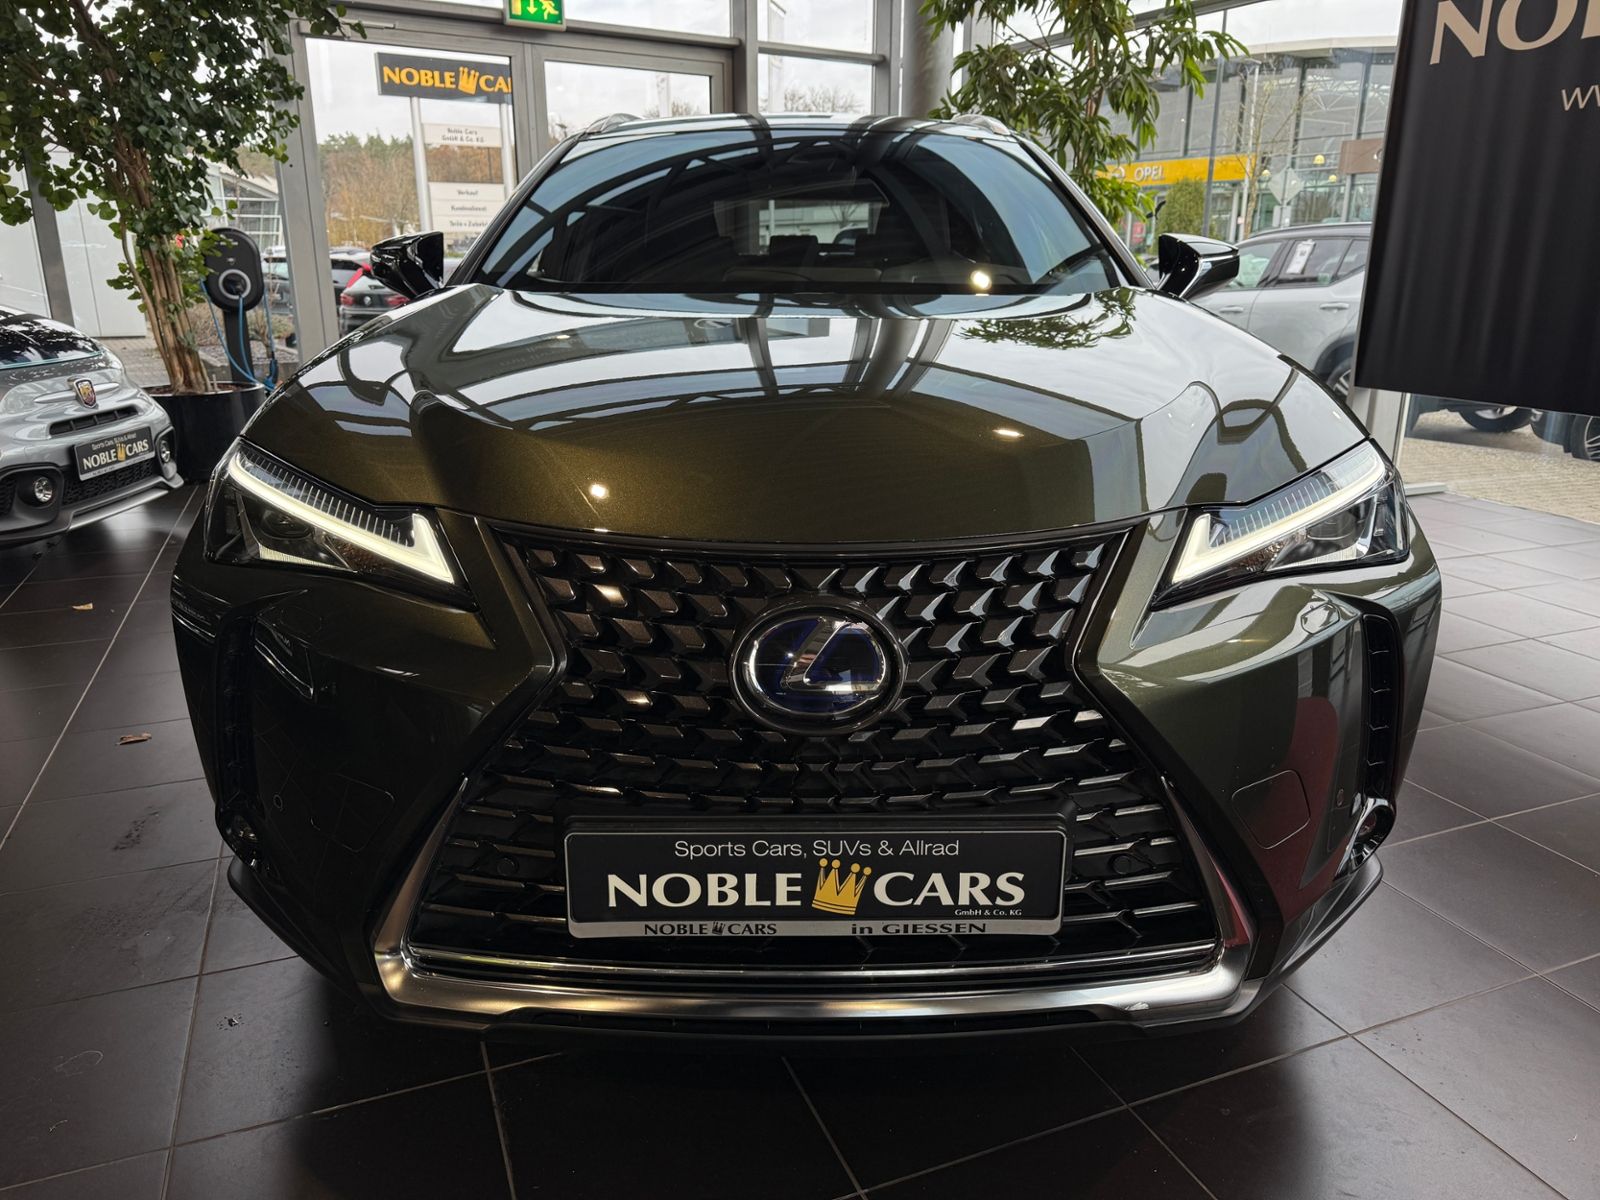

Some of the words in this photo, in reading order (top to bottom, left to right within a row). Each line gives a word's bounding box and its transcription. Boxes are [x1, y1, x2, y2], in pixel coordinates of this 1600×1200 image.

[1429, 0, 1600, 65] NO
[383, 65, 456, 89] NOBLE
[1134, 165, 1165, 181] OPEL
[83, 448, 118, 470] NOBLE
[125, 438, 149, 456] CARS
[674, 840, 746, 860] Sports
[752, 840, 808, 858] Cars,
[812, 839, 872, 857] SUVs
[877, 840, 895, 856] &
[899, 839, 960, 856] Allrad
[607, 872, 803, 908] NOBLE
[873, 871, 1026, 907] CARS
[644, 923, 709, 936] NOBLE
[727, 922, 778, 935] CARS
[851, 923, 873, 935] in
[881, 922, 987, 935] GIESSEN
